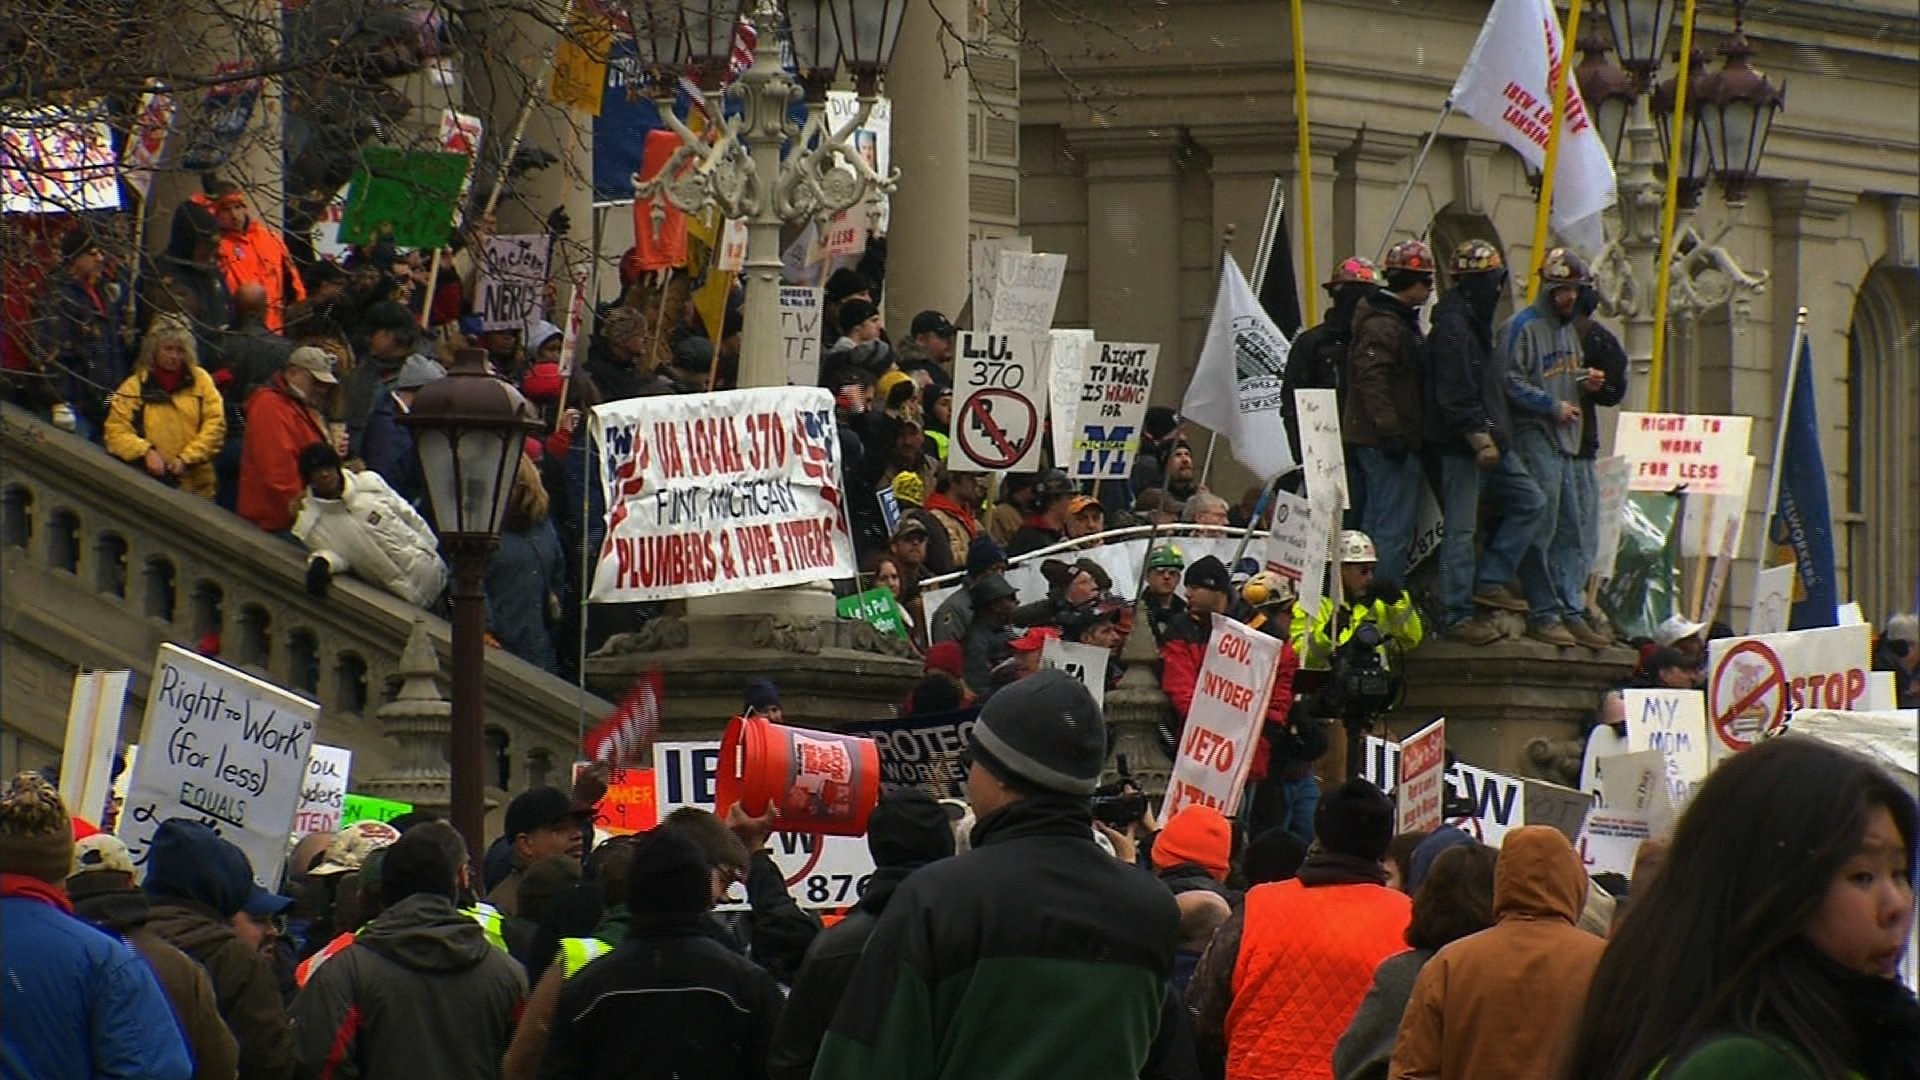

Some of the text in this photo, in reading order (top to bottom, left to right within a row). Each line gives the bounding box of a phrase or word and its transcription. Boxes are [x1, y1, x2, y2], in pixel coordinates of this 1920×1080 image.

[484, 282, 535, 322] NERD
[963, 334, 1013, 361] L.U.
[1100, 344, 1147, 368] RIGHT
[968, 361, 1025, 389] 370
[1090, 366, 1150, 387] TO WORK
[1081, 384, 1104, 402] IS
[1100, 403, 1122, 417] FOR
[1640, 417, 1721, 433] RIGHT TO
[684, 415, 745, 477] LOCAL
[746, 412, 787, 472] 370
[1659, 439, 1703, 454] WORK
[1638, 462, 1720, 479] FOR LESS
[706, 477, 798, 520] MICHIGAN
[615, 515, 837, 590] PLUMBERS & PIPE FITTERS
[1218, 633, 1252, 666] GOV.
[1791, 668, 1868, 711] STOP
[1641, 696, 1679, 724] MY
[1184, 726, 1235, 774] VETO
[1649, 731, 1693, 756] MOM
[214, 744, 269, 797] less)
[881, 760, 970, 781] WORKE
[180, 781, 248, 823] EQUALS
[806, 874, 873, 904] 876
